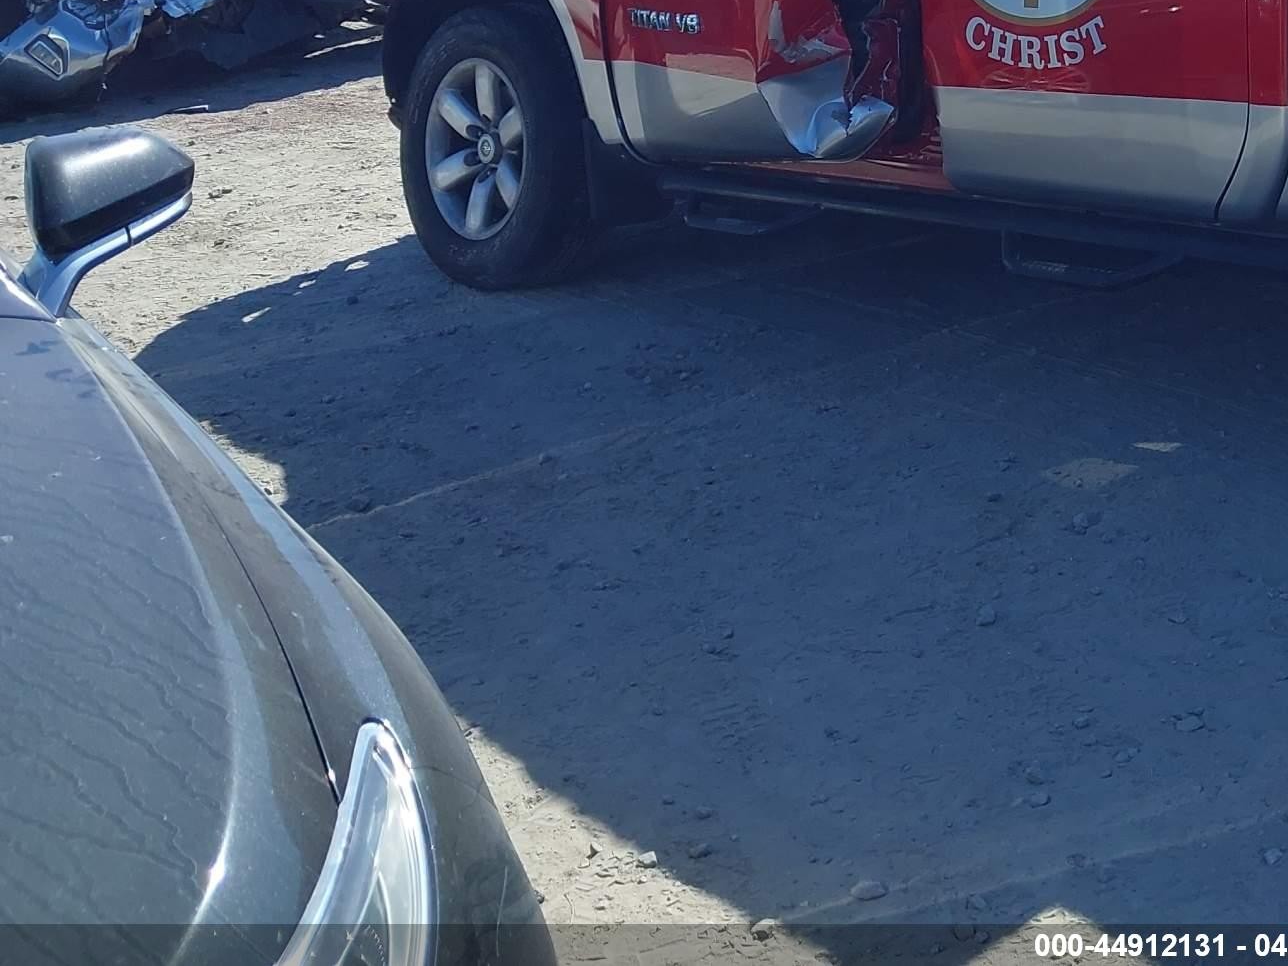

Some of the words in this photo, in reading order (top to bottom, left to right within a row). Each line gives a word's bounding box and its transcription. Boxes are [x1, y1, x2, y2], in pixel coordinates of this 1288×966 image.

[627, 7, 671, 32] TITAN
[675, 12, 700, 34] V8
[965, 15, 1108, 71] CHRIST
